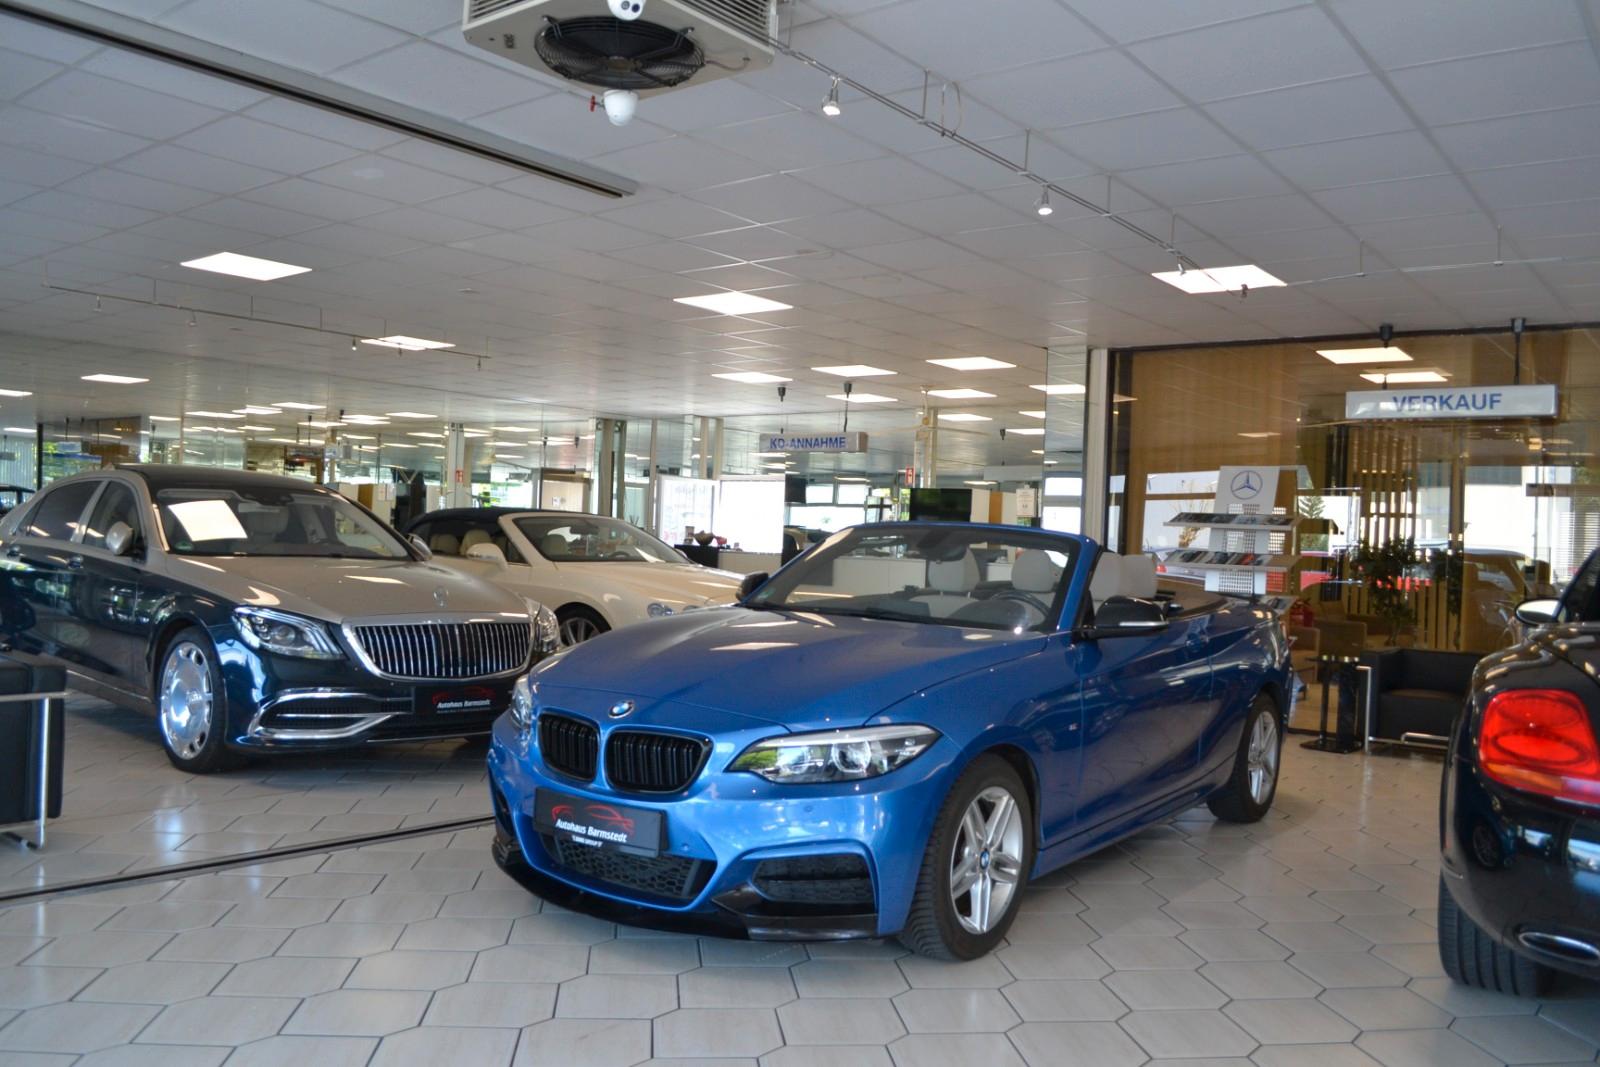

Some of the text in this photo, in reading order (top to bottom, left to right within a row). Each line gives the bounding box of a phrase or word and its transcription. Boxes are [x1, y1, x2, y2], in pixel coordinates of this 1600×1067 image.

[1392, 393, 1502, 412] VERKAUF
[555, 818, 587, 835] Autohaus
[587, 826, 628, 843] Barmstedt
